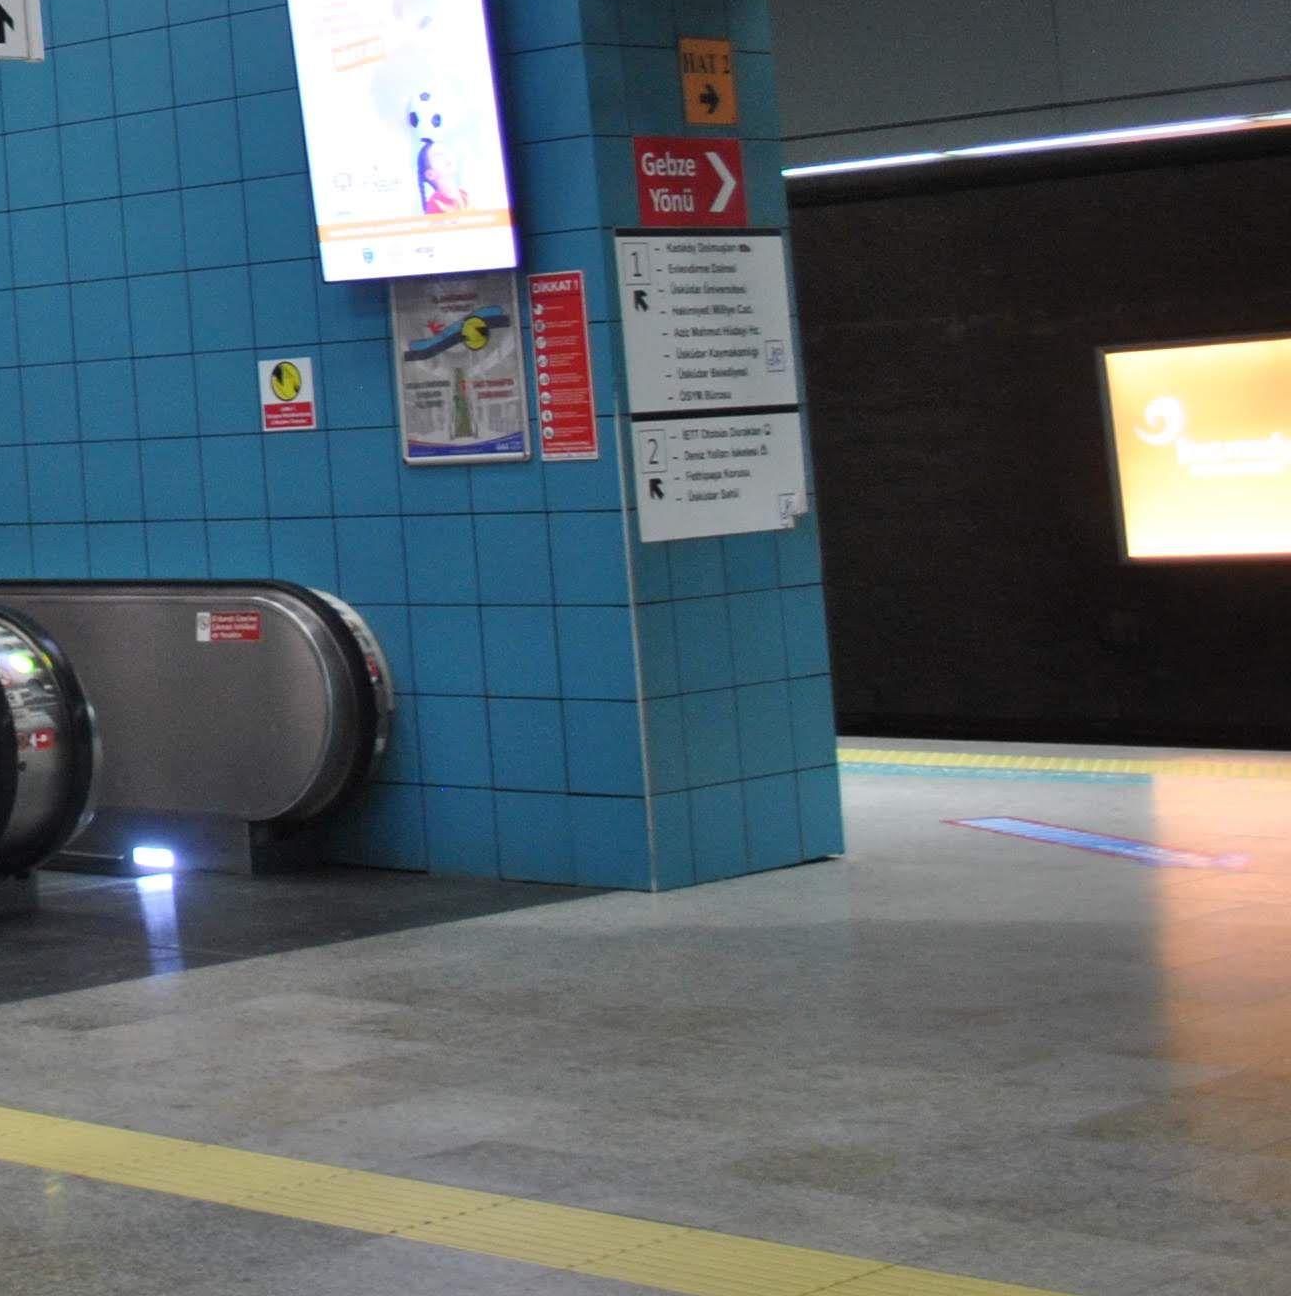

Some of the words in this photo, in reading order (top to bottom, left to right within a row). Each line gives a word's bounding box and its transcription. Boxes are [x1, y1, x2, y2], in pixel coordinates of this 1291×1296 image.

[641, 151, 696, 177] Gebze
[648, 187, 695, 213] Yönü
[631, 251, 642, 277] 1
[648, 439, 659, 465] 2
